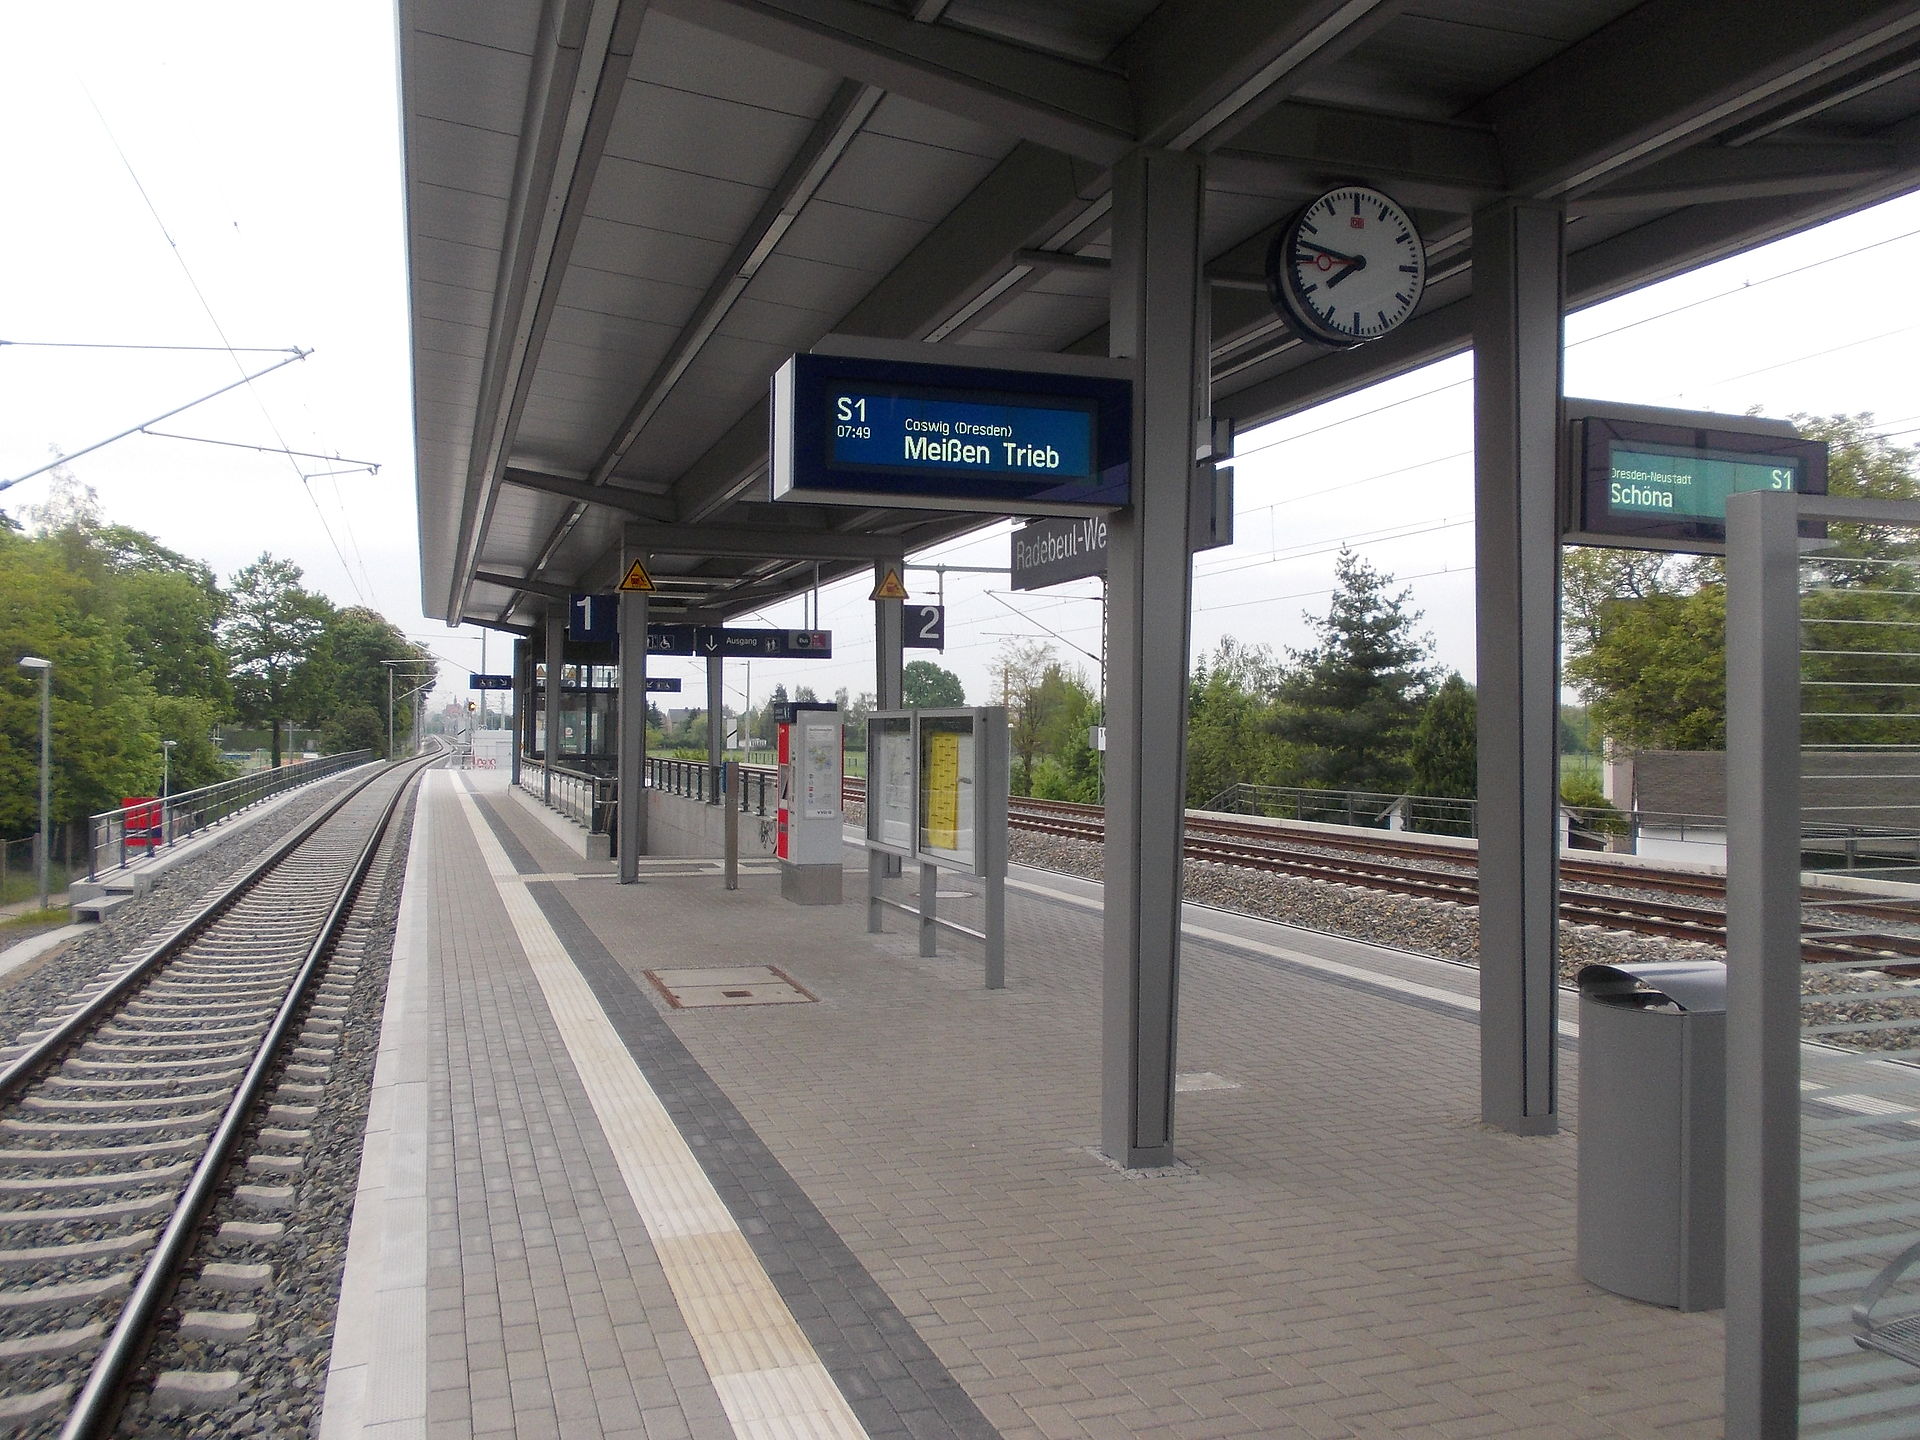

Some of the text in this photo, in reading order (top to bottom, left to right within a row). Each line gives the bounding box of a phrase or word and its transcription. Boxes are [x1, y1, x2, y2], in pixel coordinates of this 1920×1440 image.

[837, 397, 865, 422] S1
[837, 425, 871, 439] 07:49
[905, 418, 1012, 437] Coswig (Dresden)
[904, 435, 1060, 469] Meißen Trieb
[1611, 467, 1692, 485] Dresden-Neustadt
[1772, 469, 1791, 490] S1
[1611, 482, 1673, 508] Schöna
[576, 595, 591, 630] 1
[919, 606, 940, 639] 2
[726, 637, 757, 646] Ausgang
